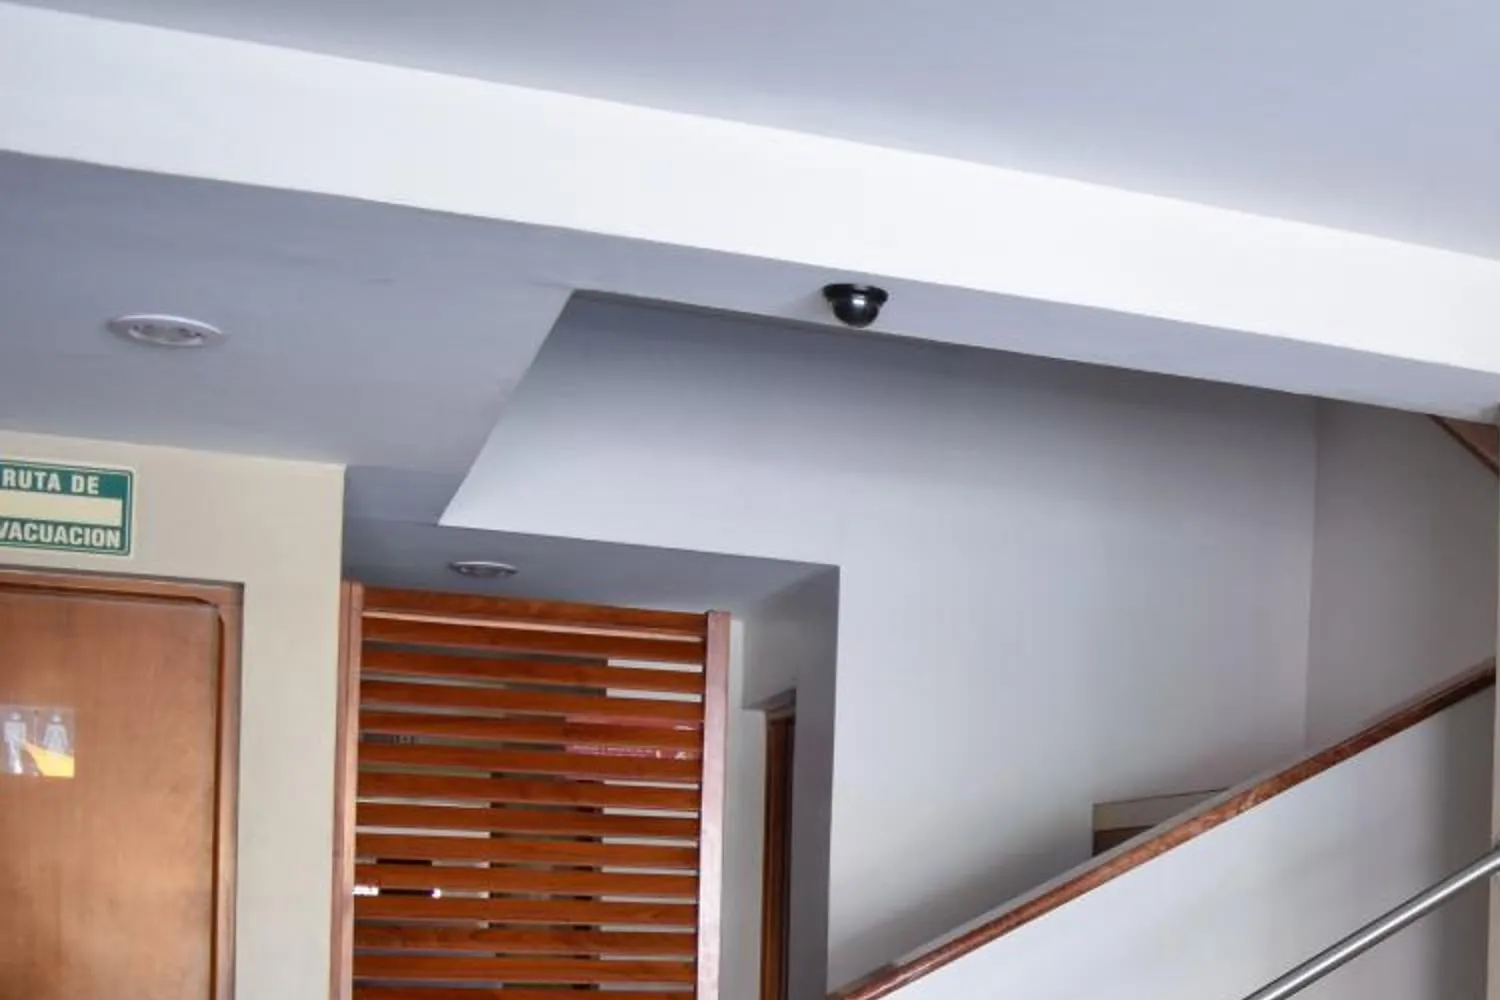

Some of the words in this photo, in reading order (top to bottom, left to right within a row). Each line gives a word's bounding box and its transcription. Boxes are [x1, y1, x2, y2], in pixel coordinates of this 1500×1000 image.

[1, 468, 61, 493] RUTA
[70, 474, 101, 496] DE
[0, 520, 121, 549] VACUACION
